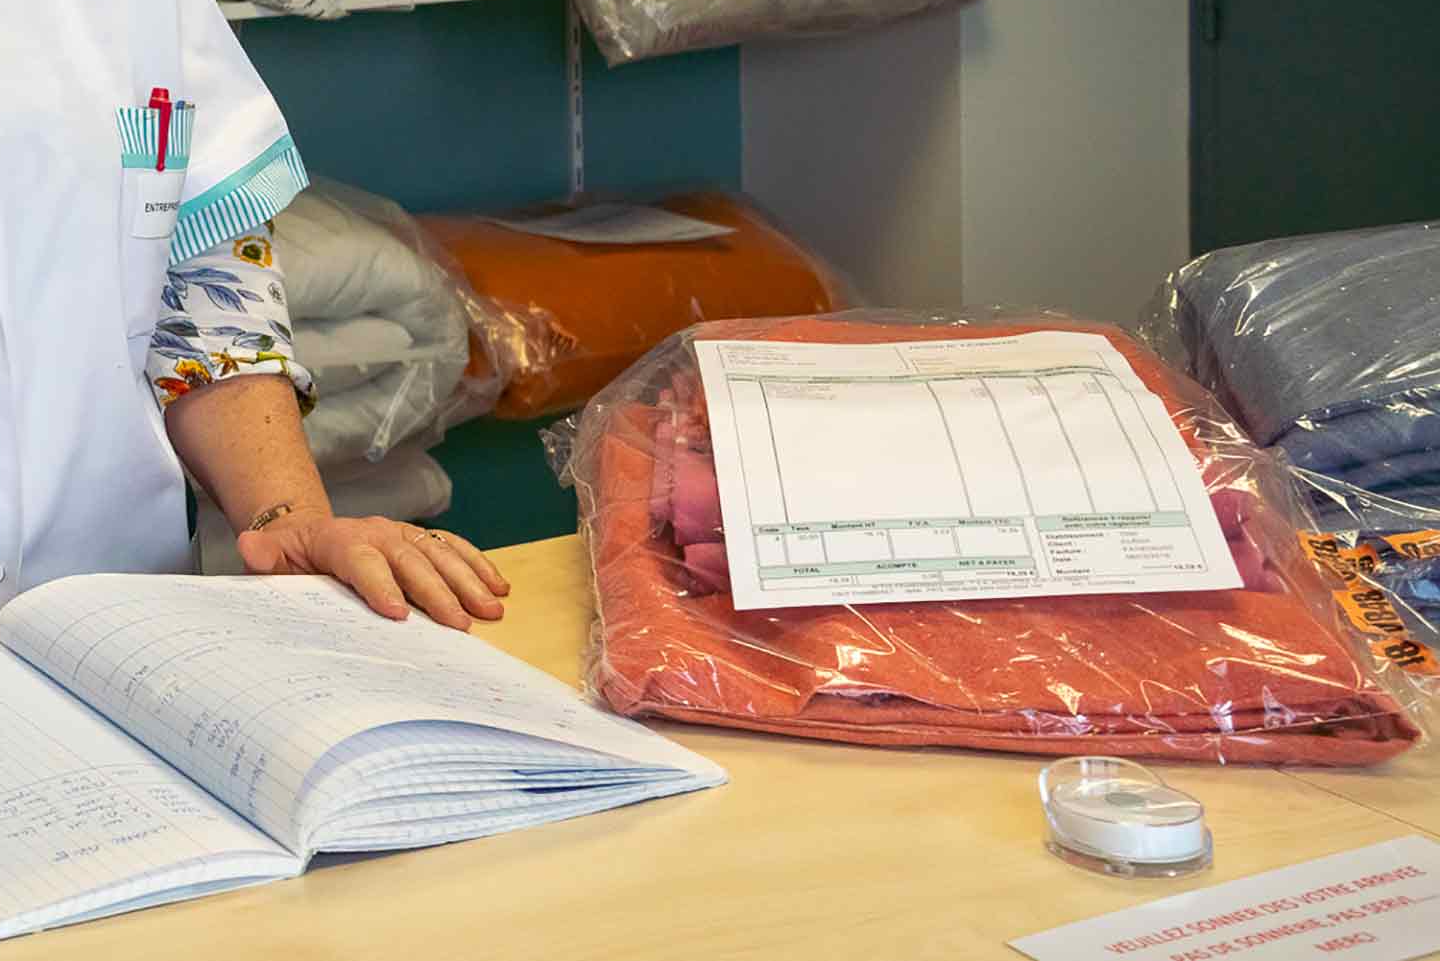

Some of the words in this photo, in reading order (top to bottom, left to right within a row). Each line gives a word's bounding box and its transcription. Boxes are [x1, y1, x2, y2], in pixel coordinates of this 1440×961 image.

[1104, 927, 1191, 954] VEUILLEZ
[1185, 907, 1264, 932] SONNER
[1291, 883, 1357, 904] VOTRE
[1326, 907, 1368, 923] PAS
[1314, 930, 1377, 952] MERCI
